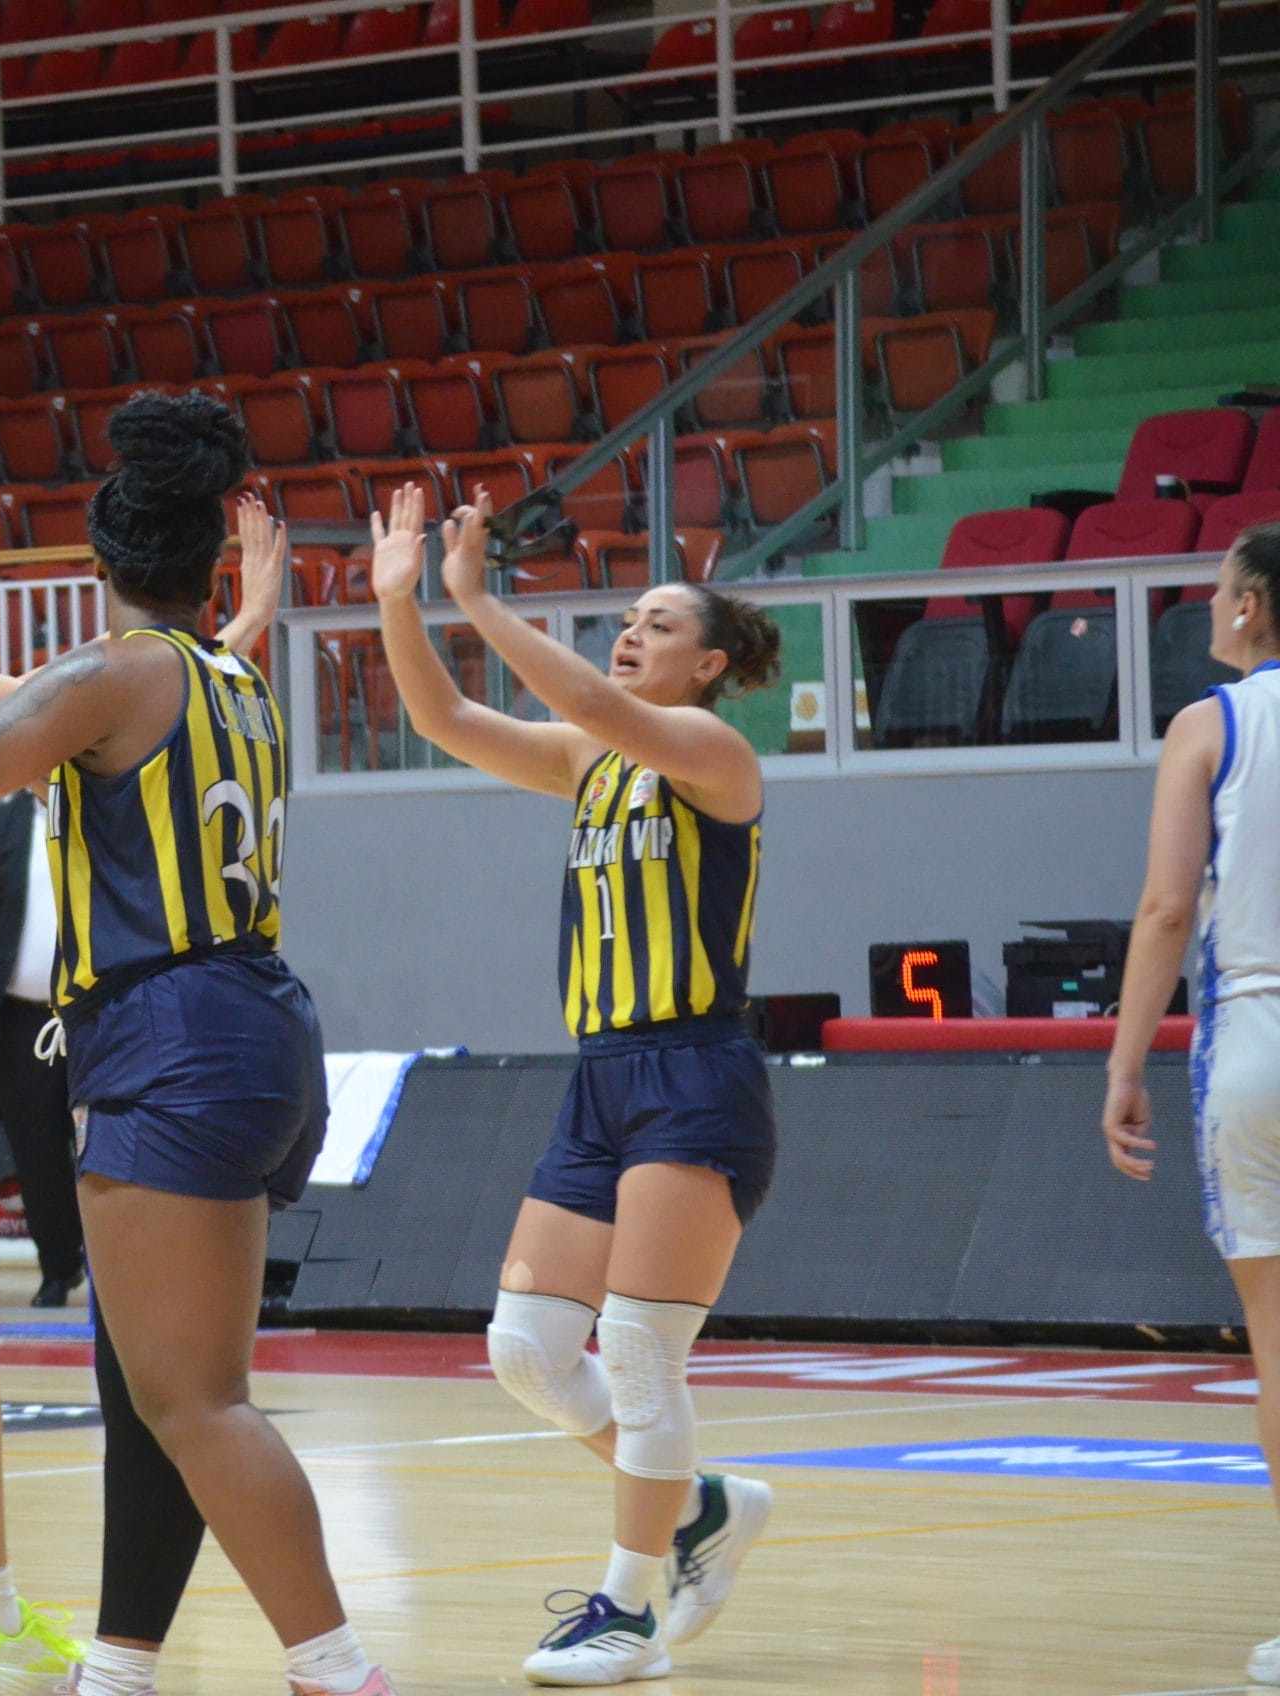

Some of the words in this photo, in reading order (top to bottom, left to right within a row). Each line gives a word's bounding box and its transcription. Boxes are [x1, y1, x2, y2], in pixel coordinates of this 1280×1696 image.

[630, 816, 674, 860] VIP
[596, 874, 616, 939] 1
[902, 950, 944, 1024] 5
